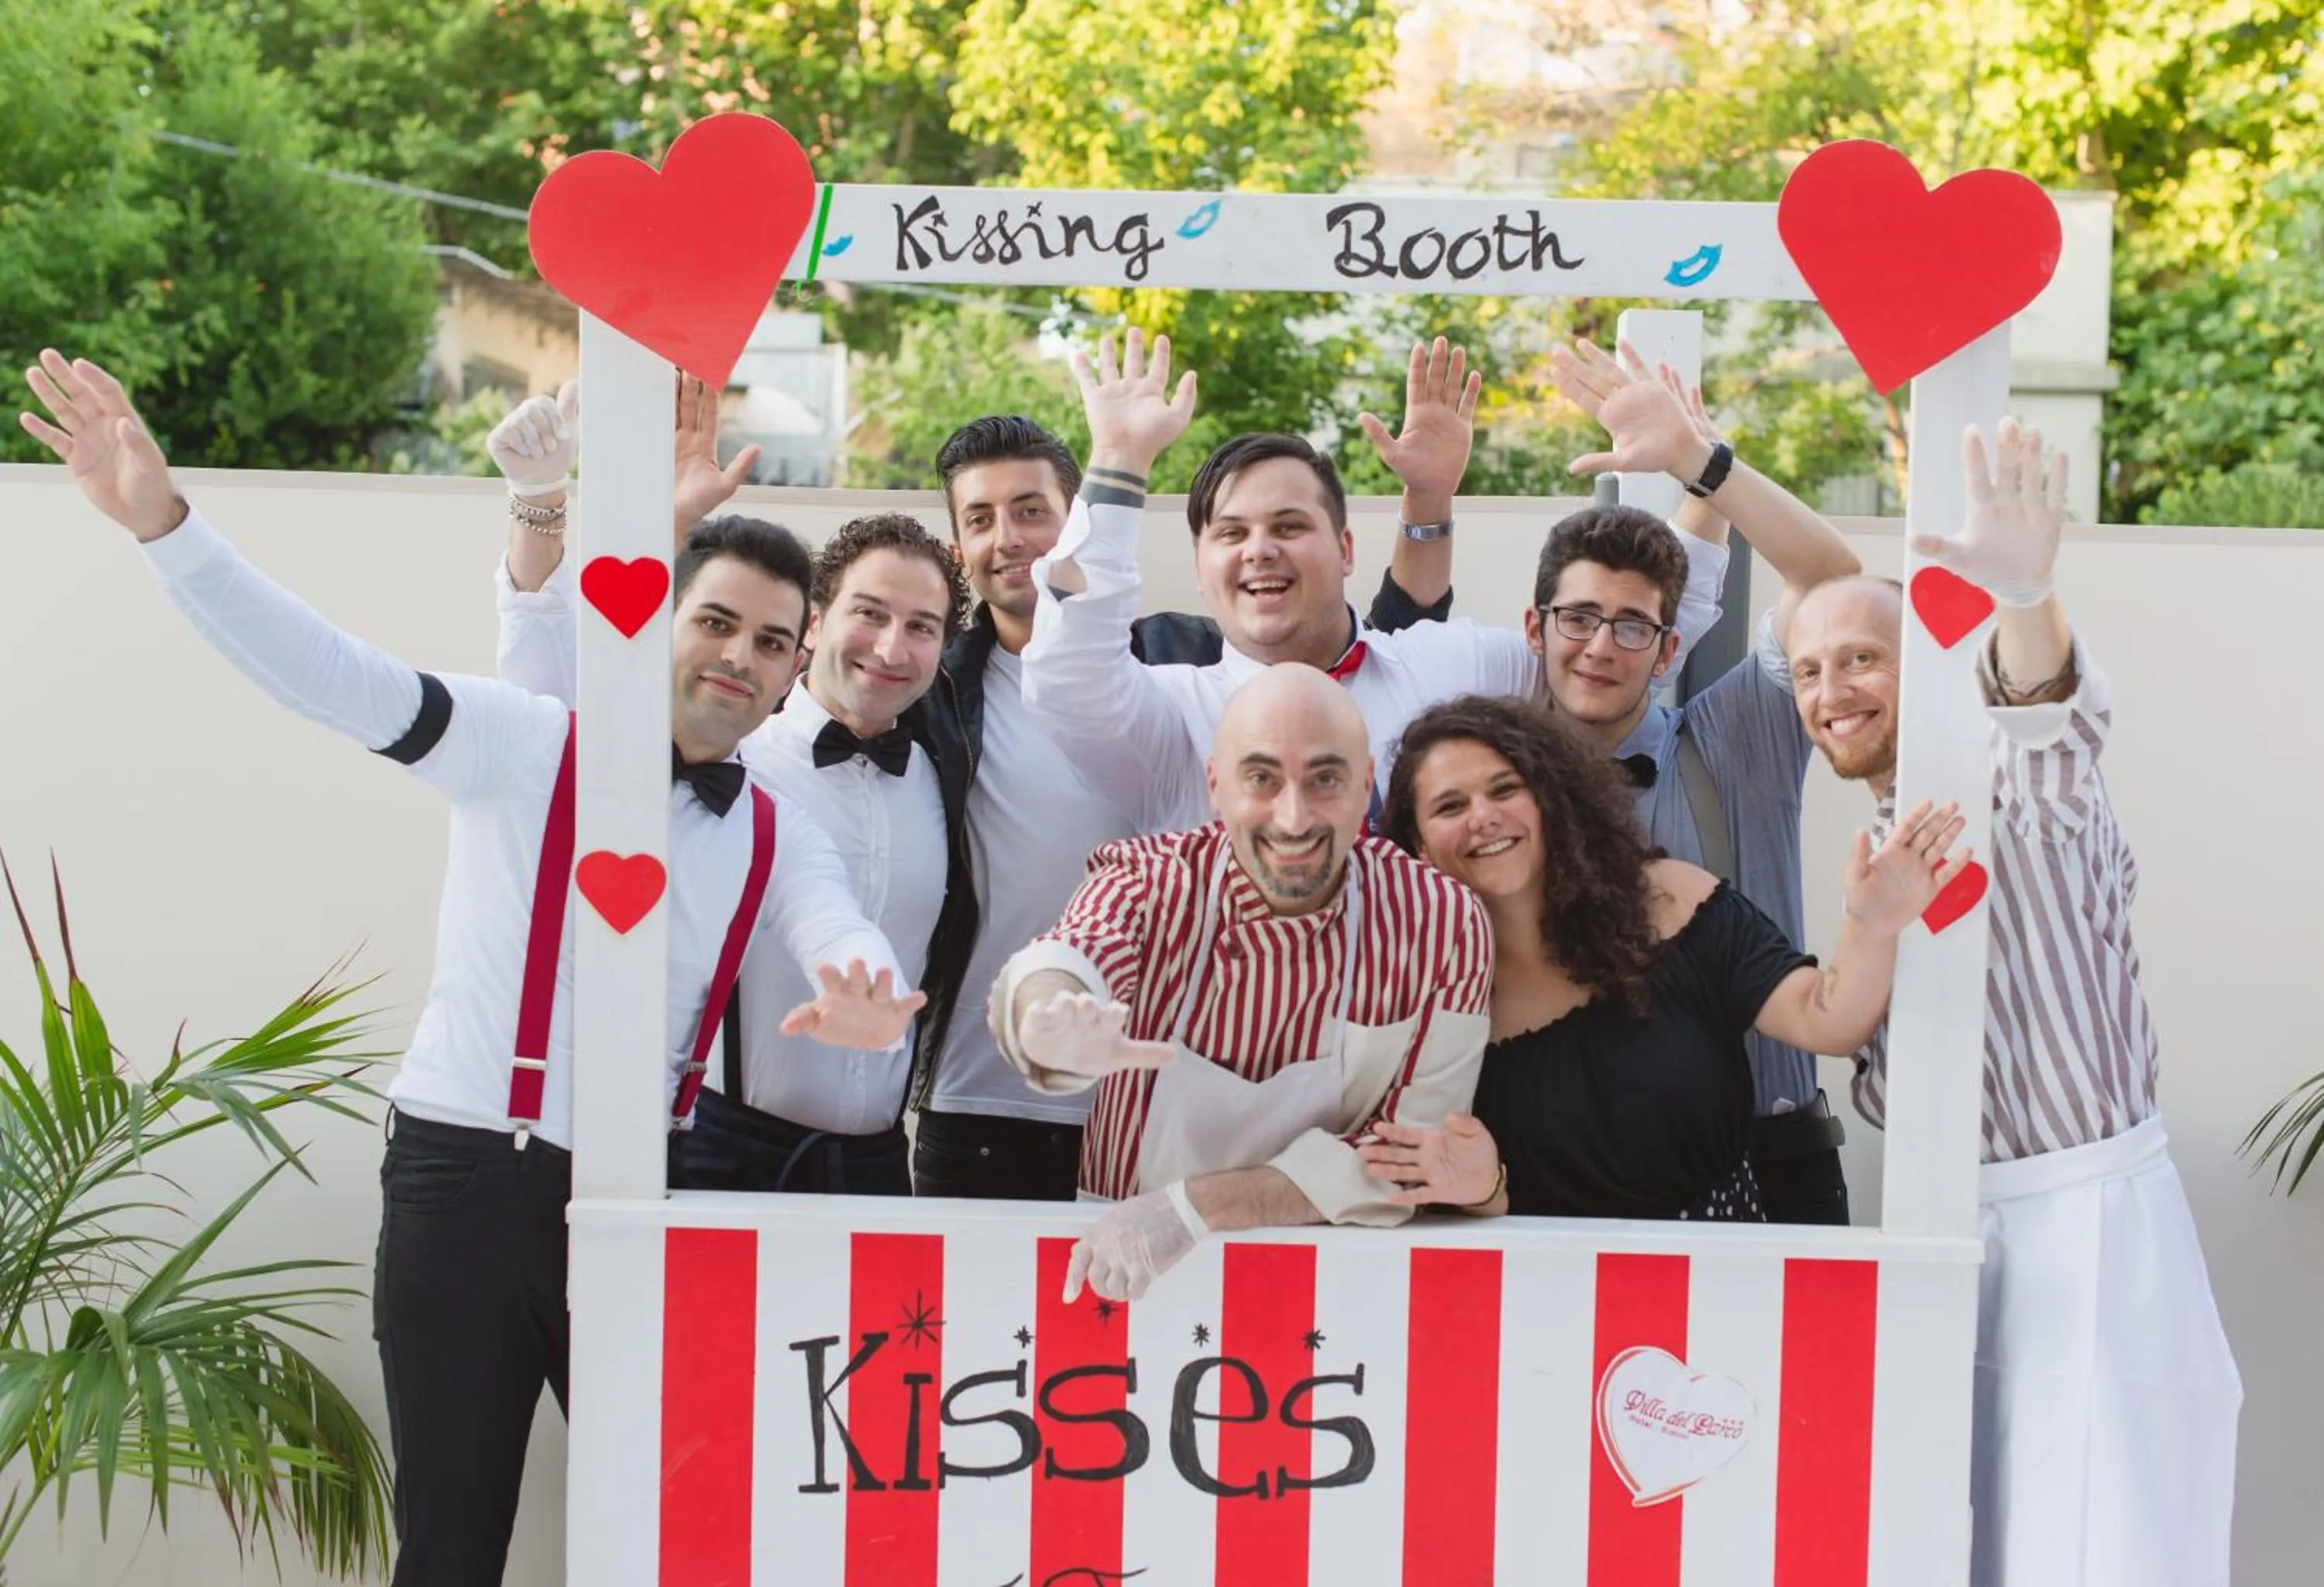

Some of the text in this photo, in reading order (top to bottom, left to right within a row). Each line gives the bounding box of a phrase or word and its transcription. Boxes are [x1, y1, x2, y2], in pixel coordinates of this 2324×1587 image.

[892, 195, 1585, 281] Kissing Booth
[789, 1291, 1375, 1500] Kisses
